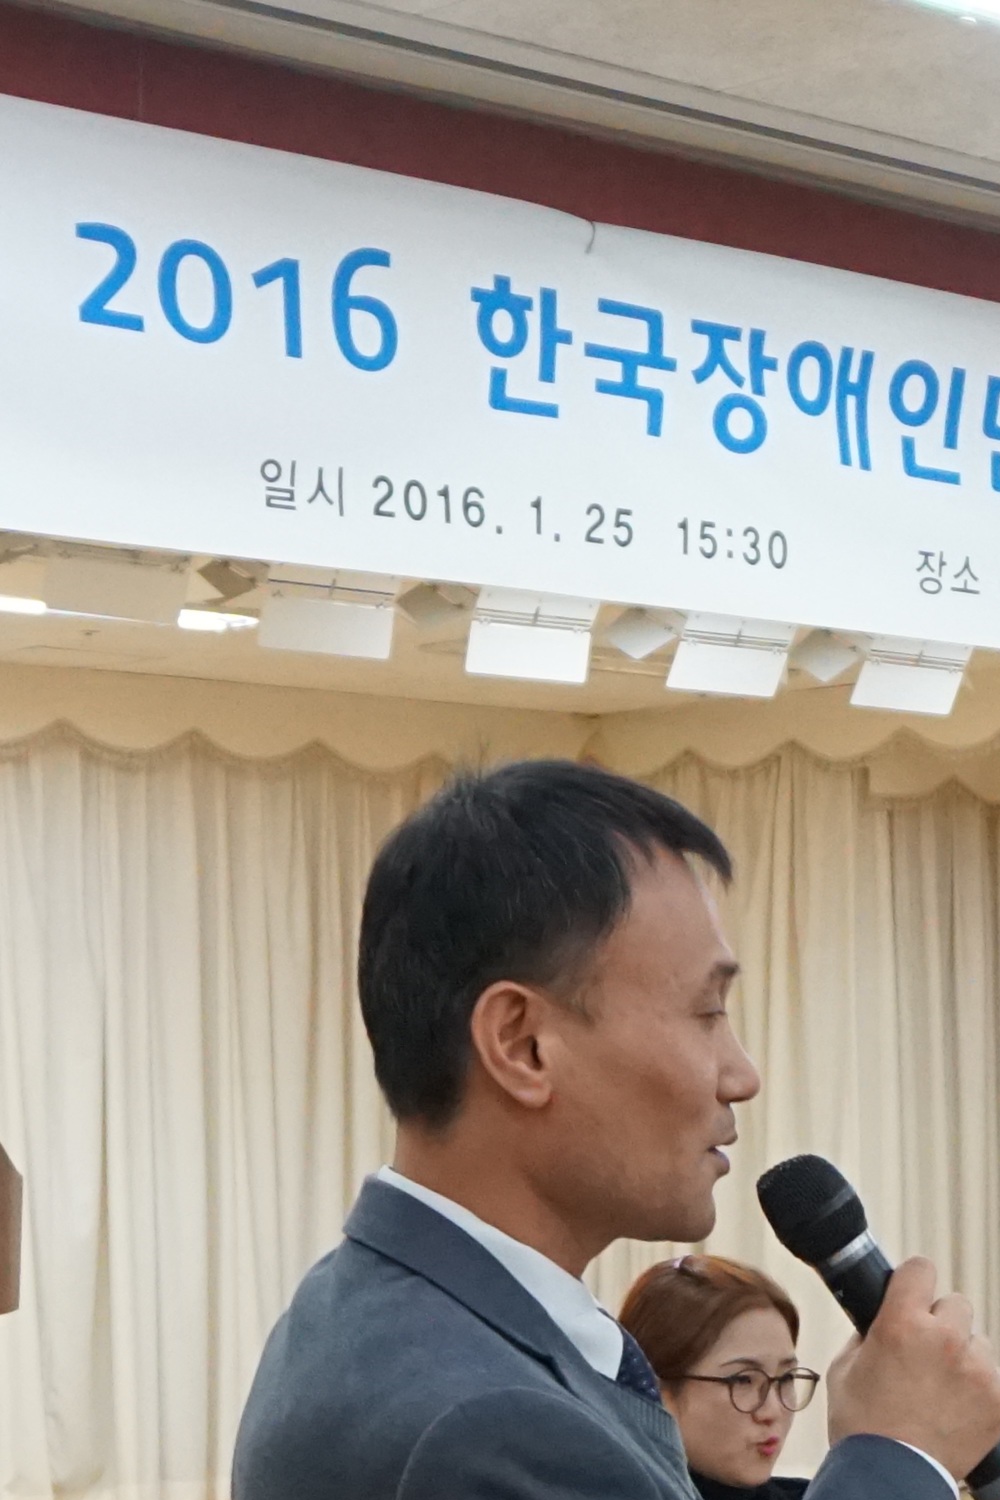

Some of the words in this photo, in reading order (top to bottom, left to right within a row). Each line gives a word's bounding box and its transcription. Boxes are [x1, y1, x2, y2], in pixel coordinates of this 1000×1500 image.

[75, 222, 399, 372] 2016
[259, 458, 346, 517] 일시
[371, 474, 504, 535] 2016.
[529, 496, 561, 543] 1.
[584, 502, 635, 548] 25
[676, 517, 788, 570] 15:30
[915, 550, 981, 596] 장소
